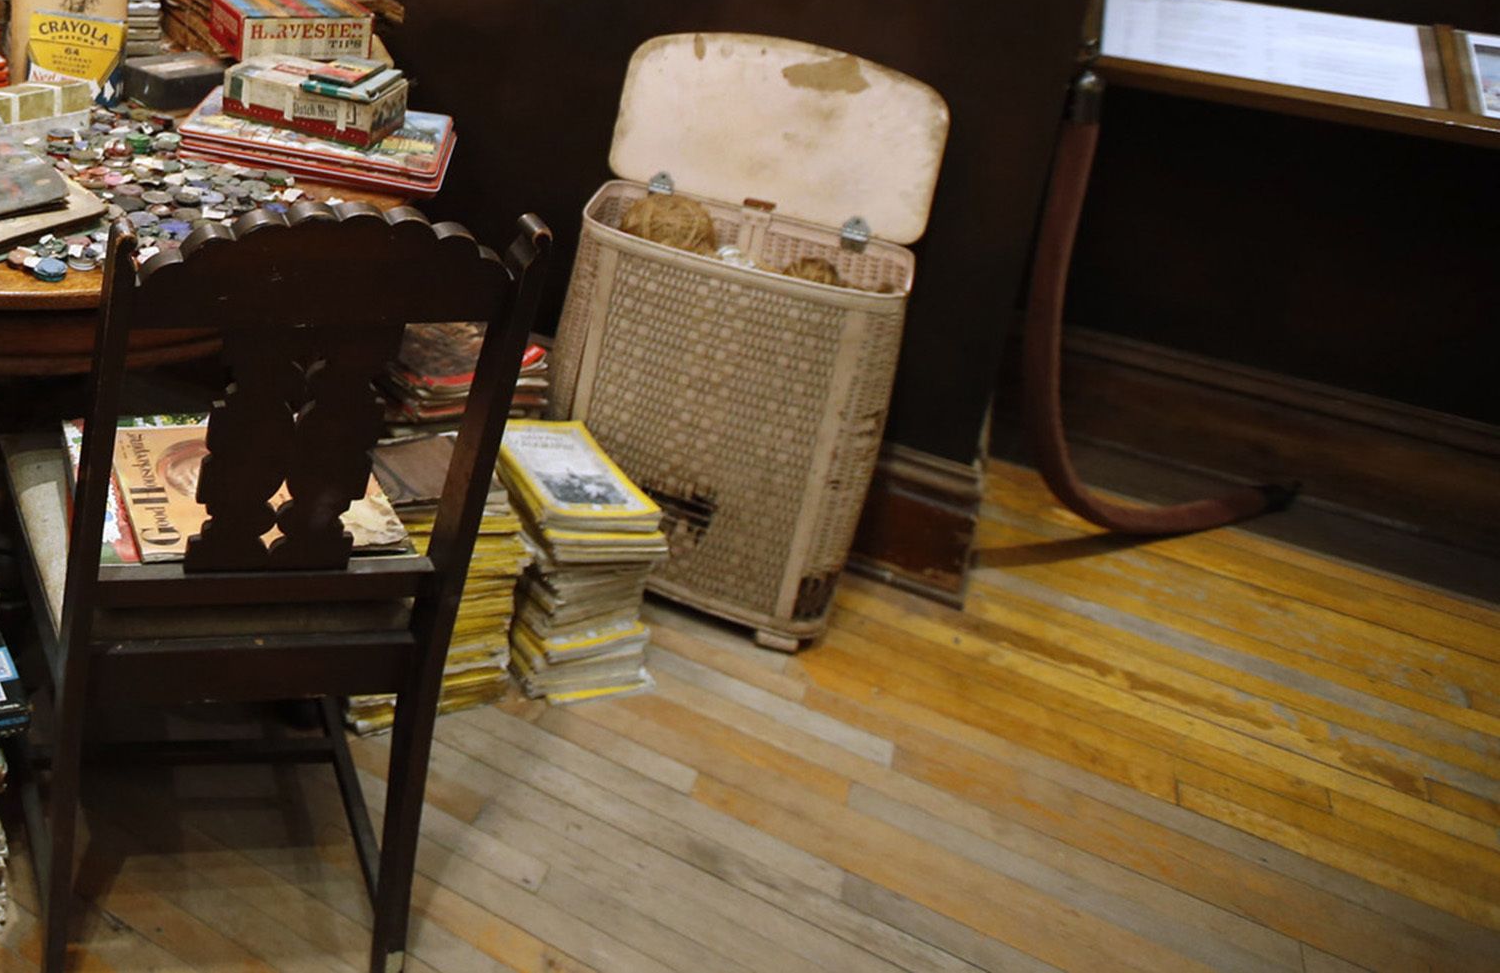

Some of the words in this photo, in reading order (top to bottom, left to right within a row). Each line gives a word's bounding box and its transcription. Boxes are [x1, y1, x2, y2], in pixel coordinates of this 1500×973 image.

[38, 20, 109, 46] CRAYOLA
[63, 47, 80, 56] 64
[328, 40, 362, 49] TIPS
[140, 507, 181, 545] Good
